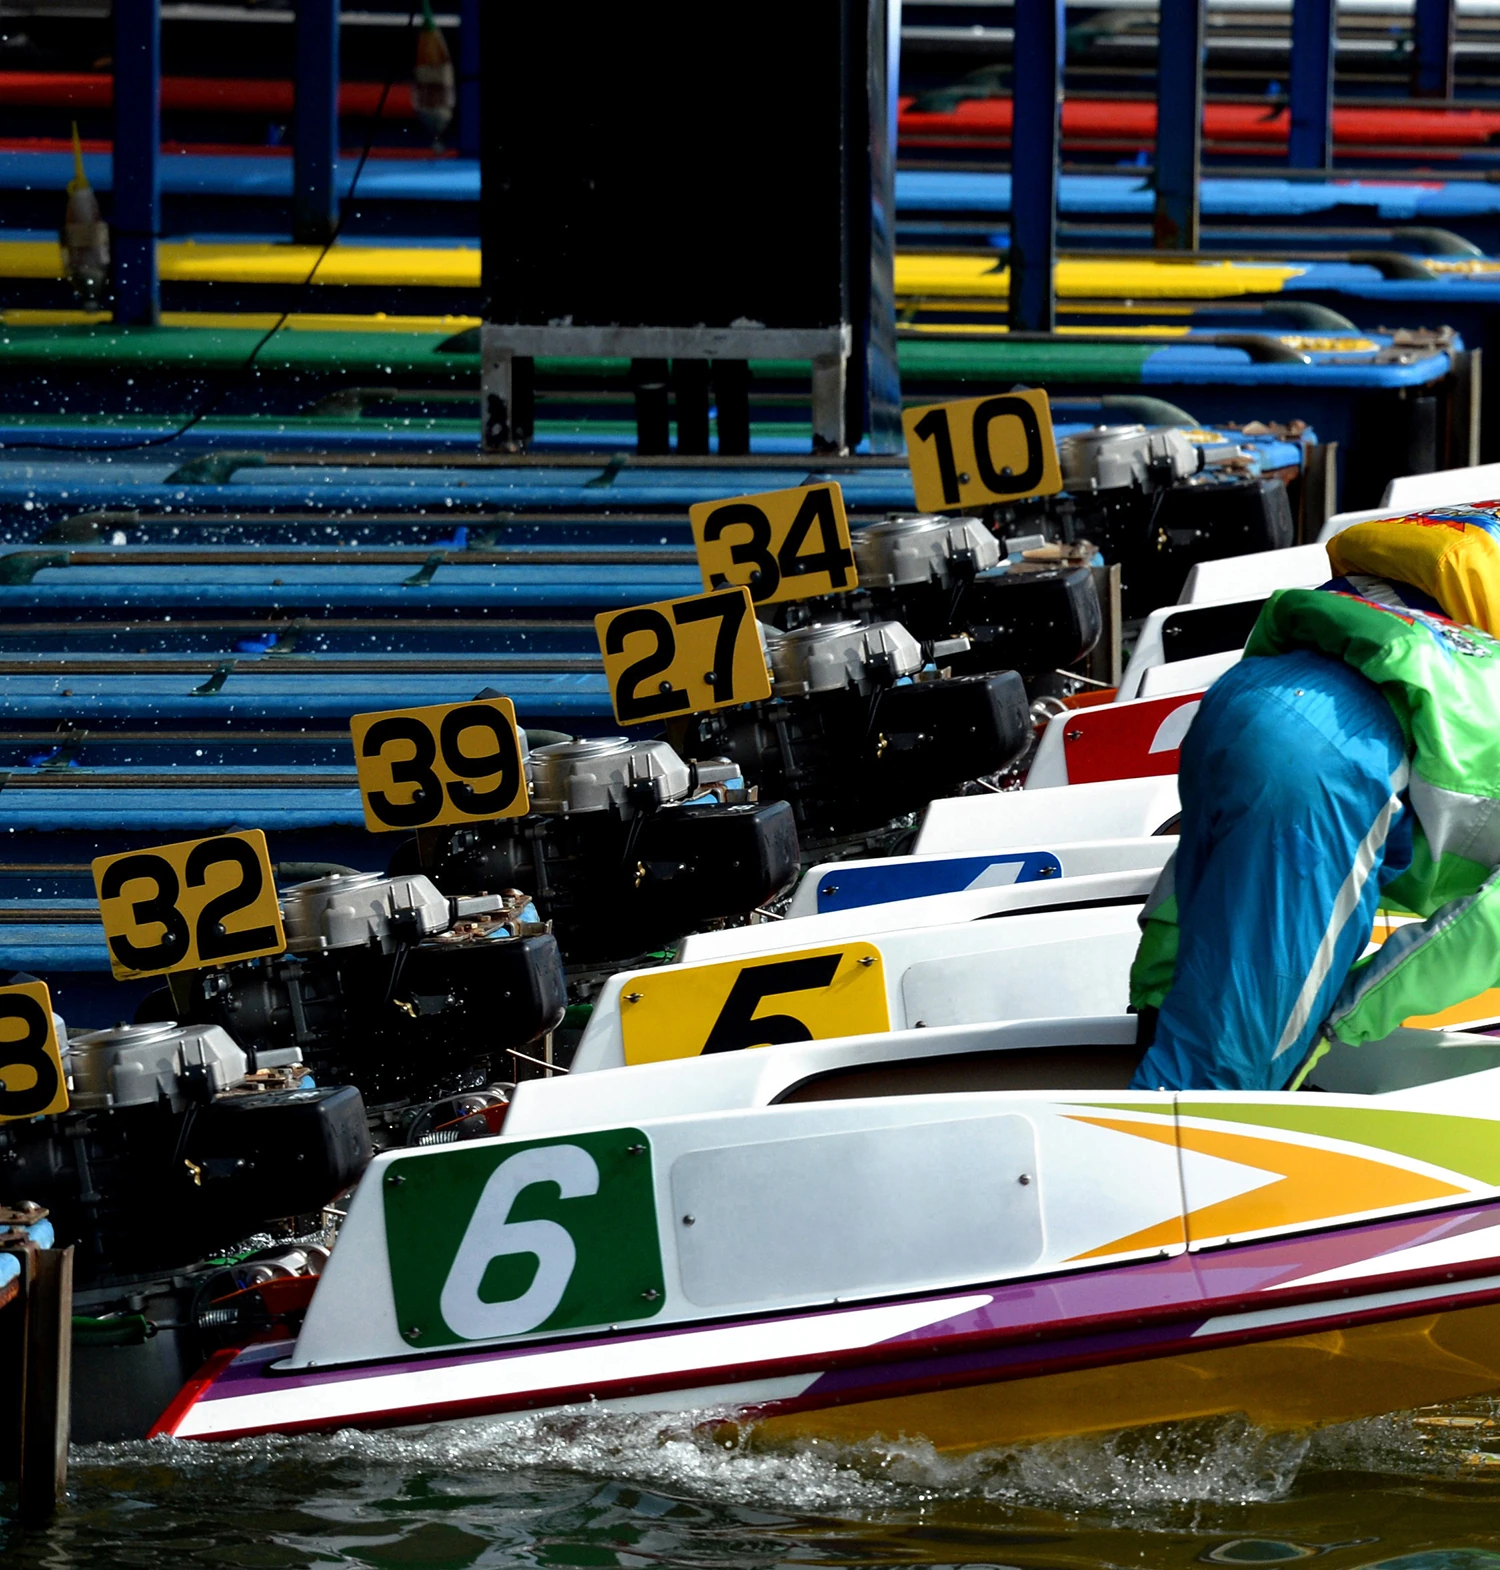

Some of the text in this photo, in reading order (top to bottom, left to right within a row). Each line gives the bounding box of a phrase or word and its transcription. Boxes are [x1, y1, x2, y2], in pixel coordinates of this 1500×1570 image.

[913, 397, 1045, 505] 10
[703, 487, 852, 603] 34
[605, 592, 747, 722] 27
[362, 704, 522, 827] 39
[101, 836, 278, 972] 32
[700, 953, 843, 1055] 5
[440, 1143, 600, 1341] 6
